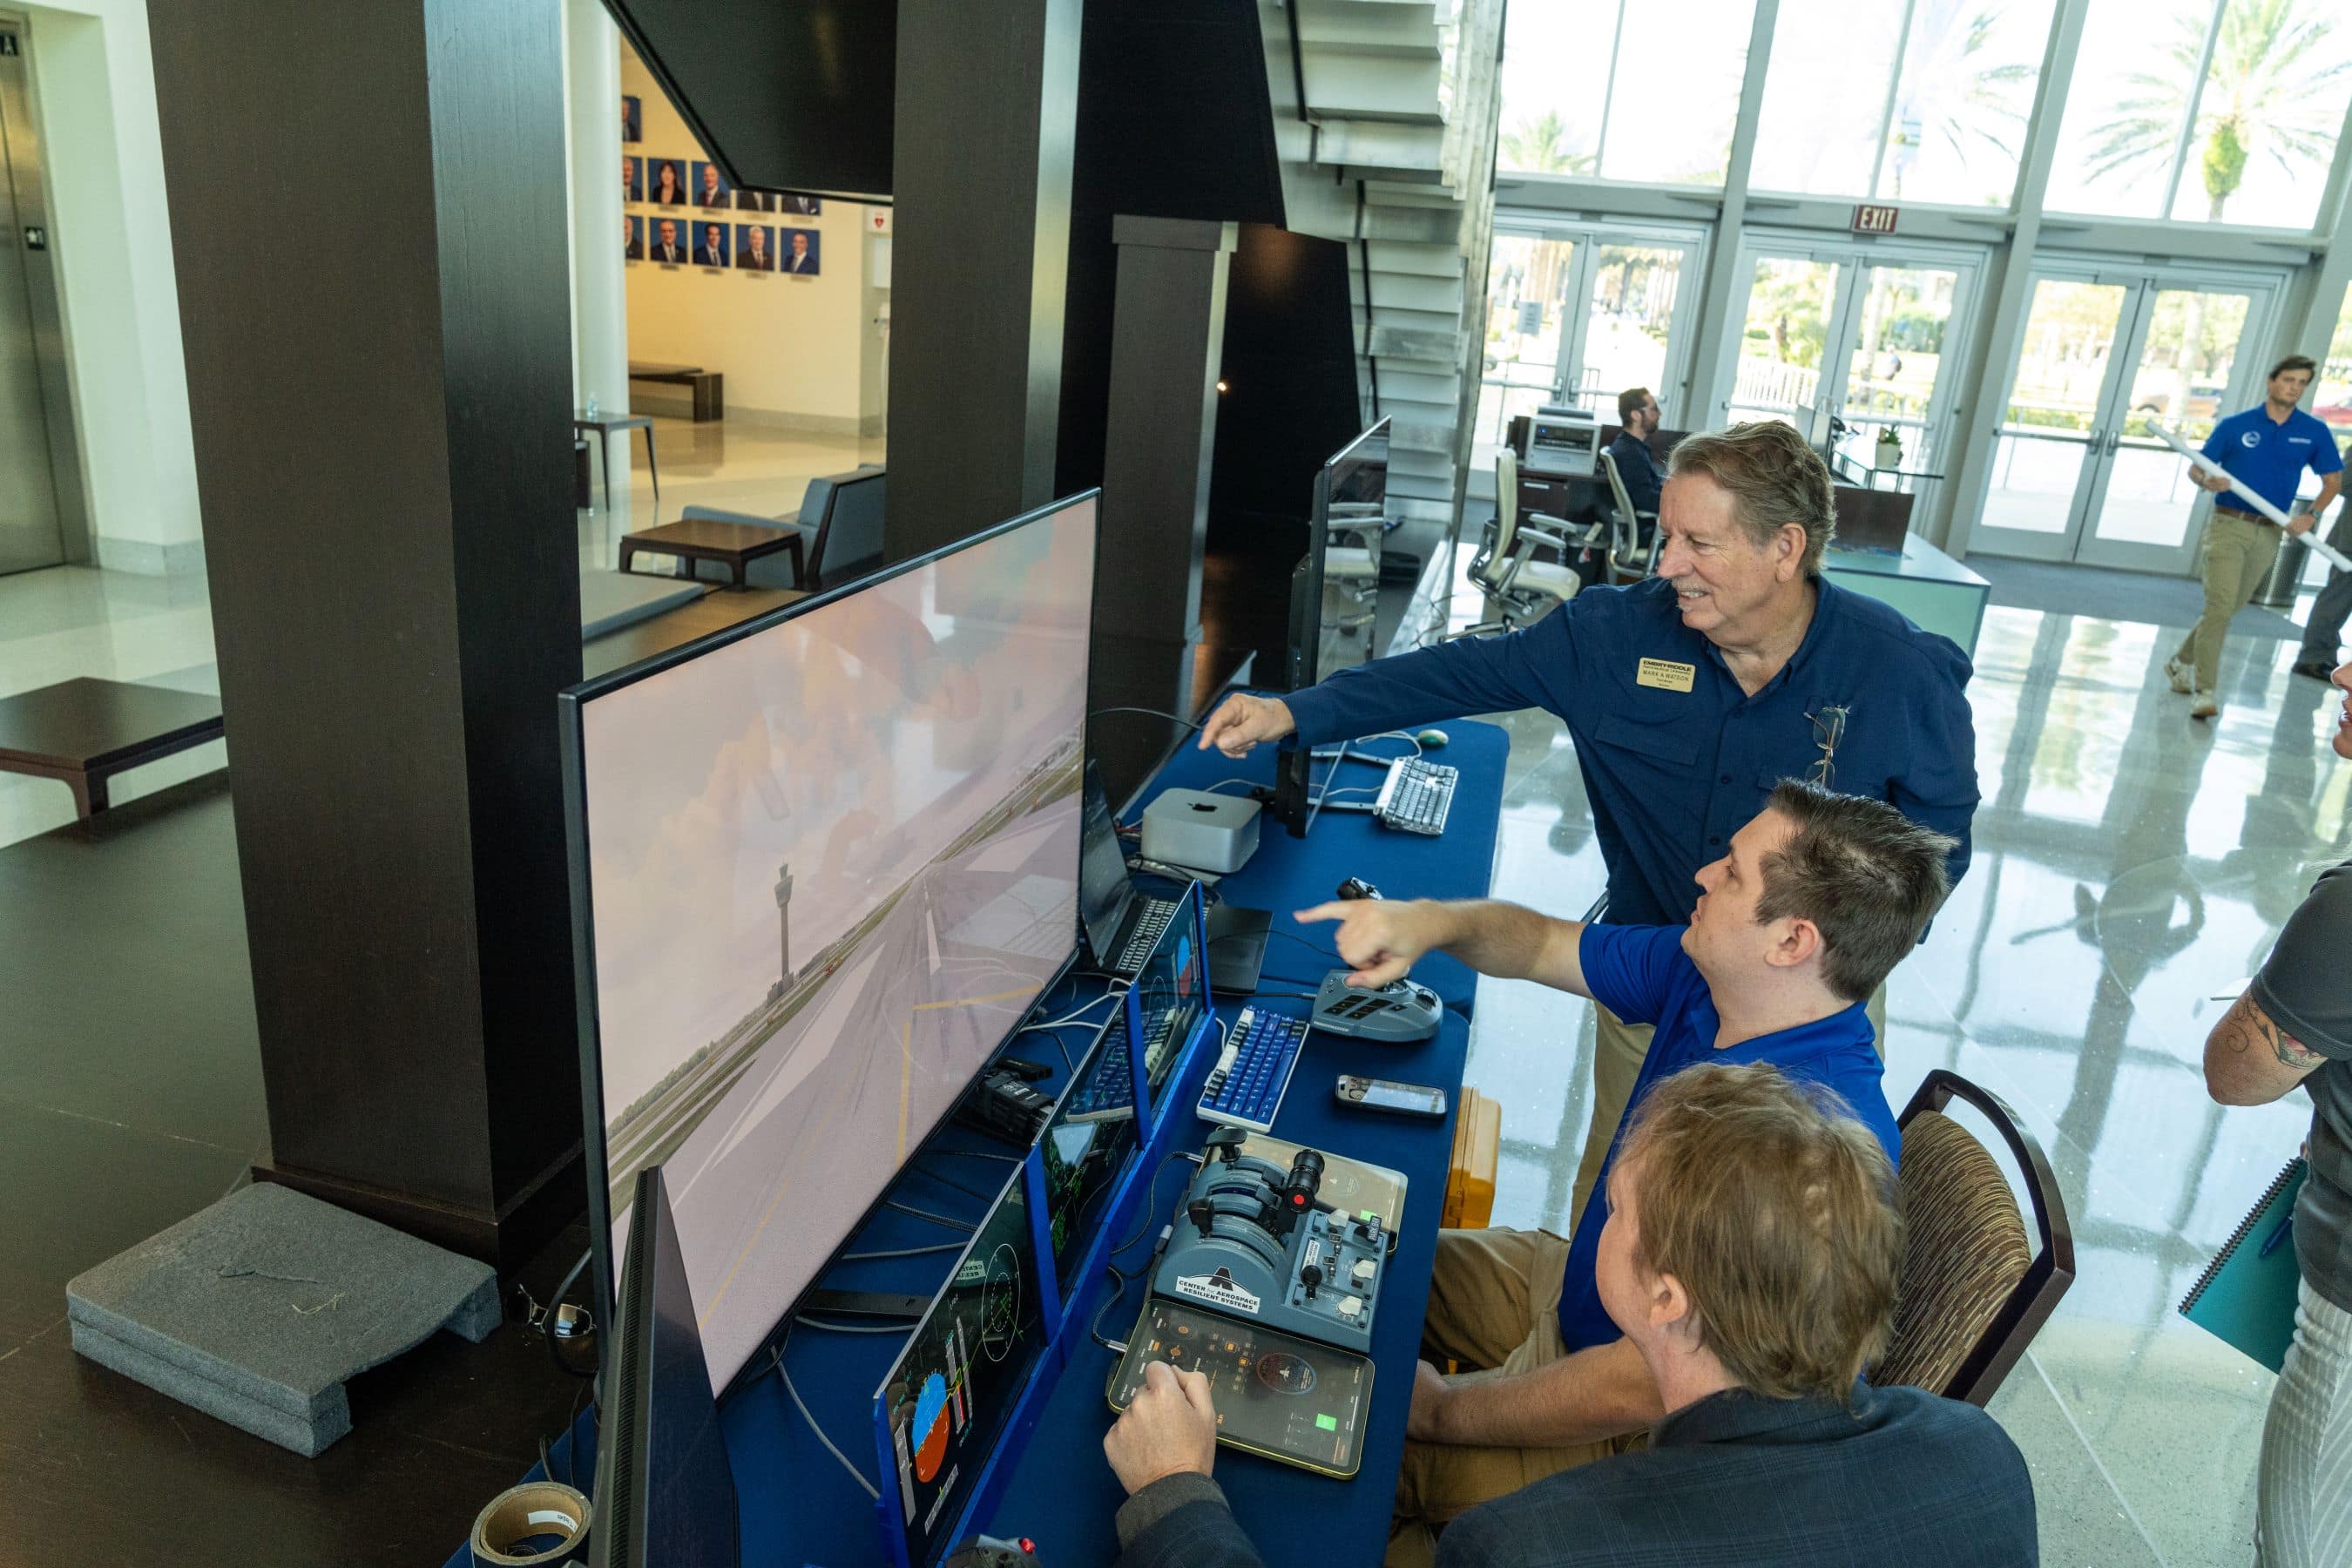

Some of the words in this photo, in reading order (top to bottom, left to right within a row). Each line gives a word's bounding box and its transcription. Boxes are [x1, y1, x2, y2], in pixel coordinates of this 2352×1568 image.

[1859, 206, 1896, 231] EXIT
[1179, 1280, 1206, 1292] CENTER
[1216, 1291, 1258, 1306] AEROSPACE
[1183, 1288, 1219, 1301] RESILIENT
[1220, 1297, 1254, 1310] SYSTEMS
